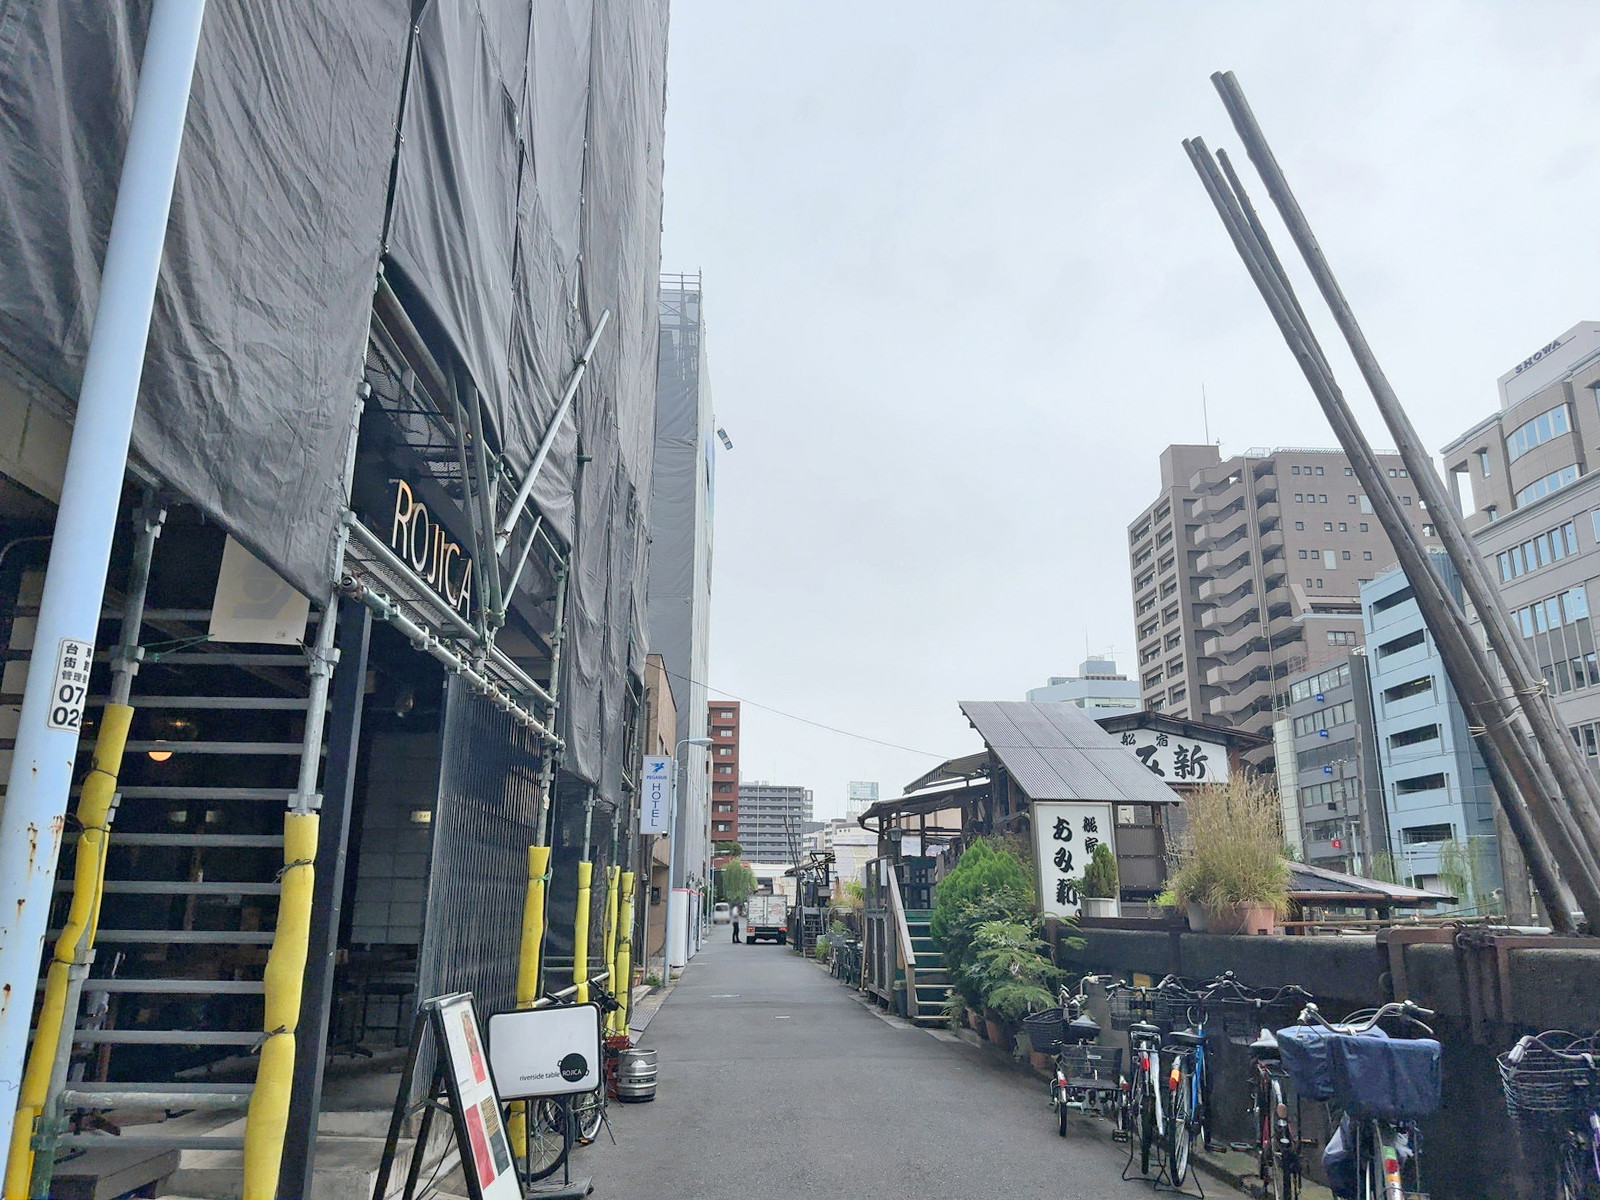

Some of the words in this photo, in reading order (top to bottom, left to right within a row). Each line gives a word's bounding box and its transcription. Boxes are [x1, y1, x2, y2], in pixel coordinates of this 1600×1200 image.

[1516, 340, 1561, 373] SHOWA
[391, 479, 473, 621] ROJICA
[59, 685, 85, 705] 07
[53, 707, 80, 728] 02
[1136, 744, 1209, 780] み新
[650, 783, 662, 827] HOTEL
[1052, 816, 1078, 906] あみ新
[519, 1073, 545, 1081] riverside
[562, 1069, 582, 1077] ROJICA
